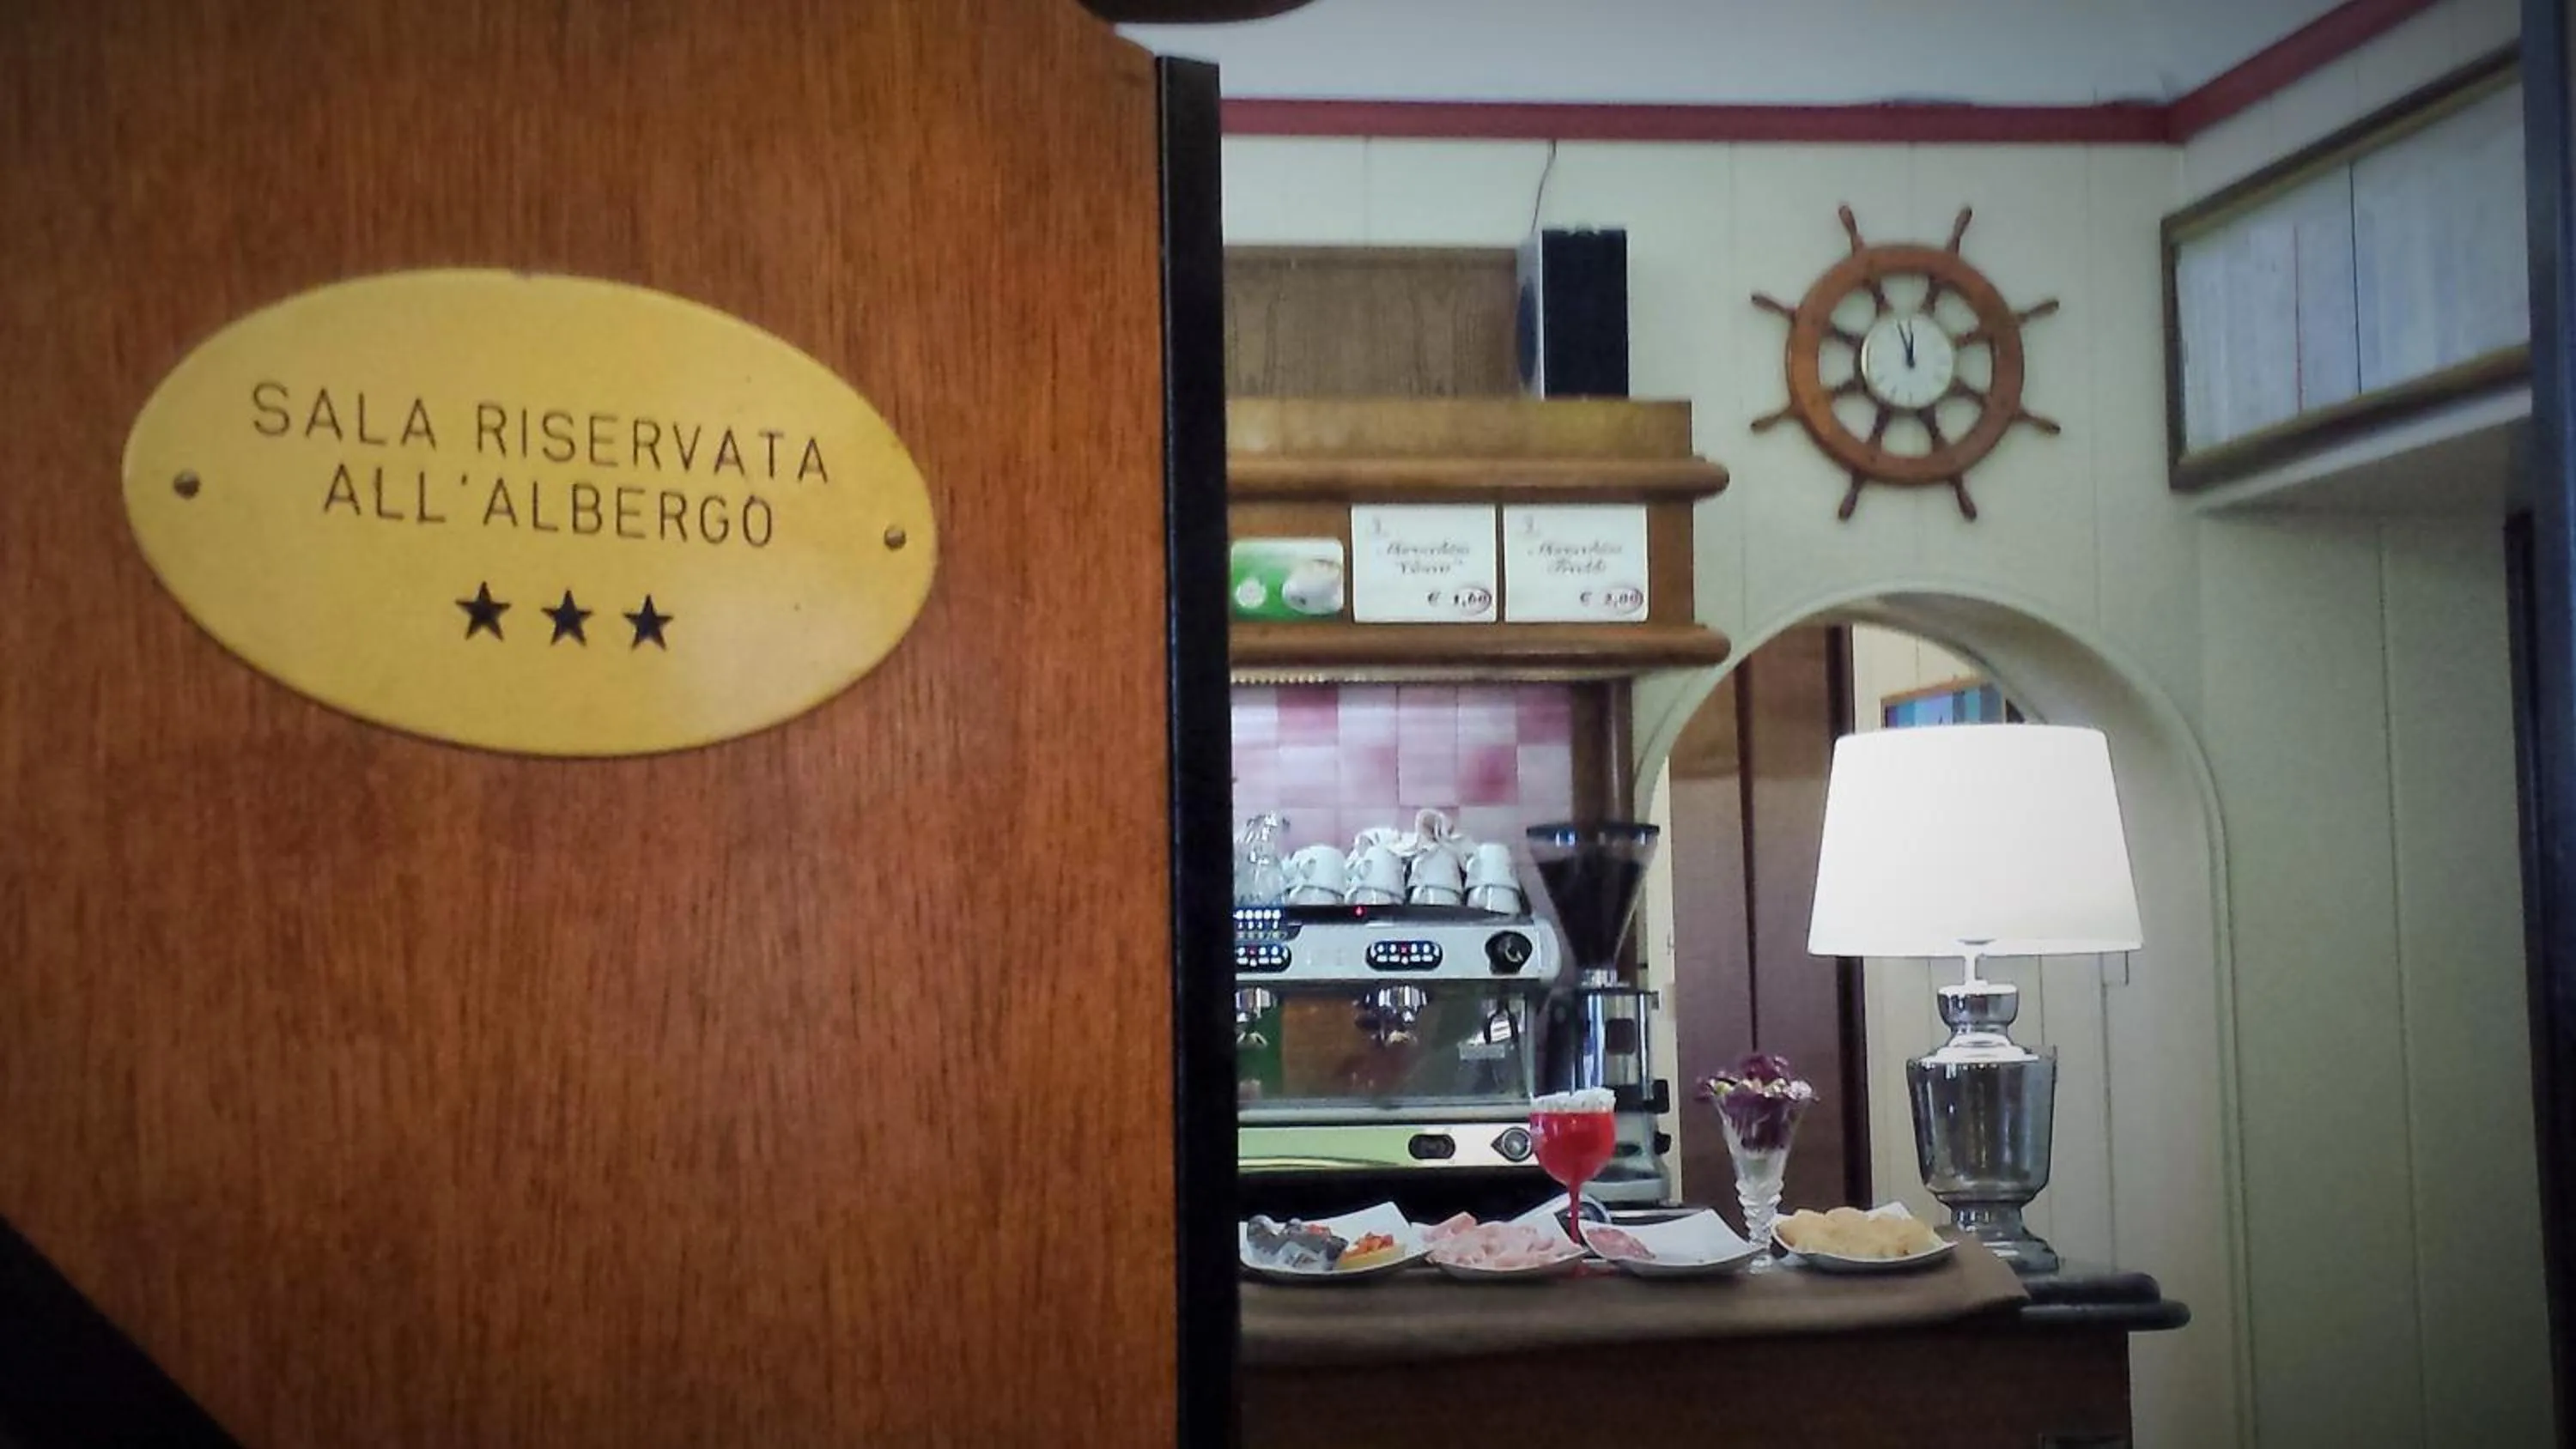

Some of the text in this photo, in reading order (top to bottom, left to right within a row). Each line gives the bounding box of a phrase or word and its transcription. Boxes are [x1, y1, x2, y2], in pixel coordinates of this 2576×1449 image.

[252, 382, 829, 486] SALA RISERVATA
[323, 463, 774, 549] ALL'ALBERGO
